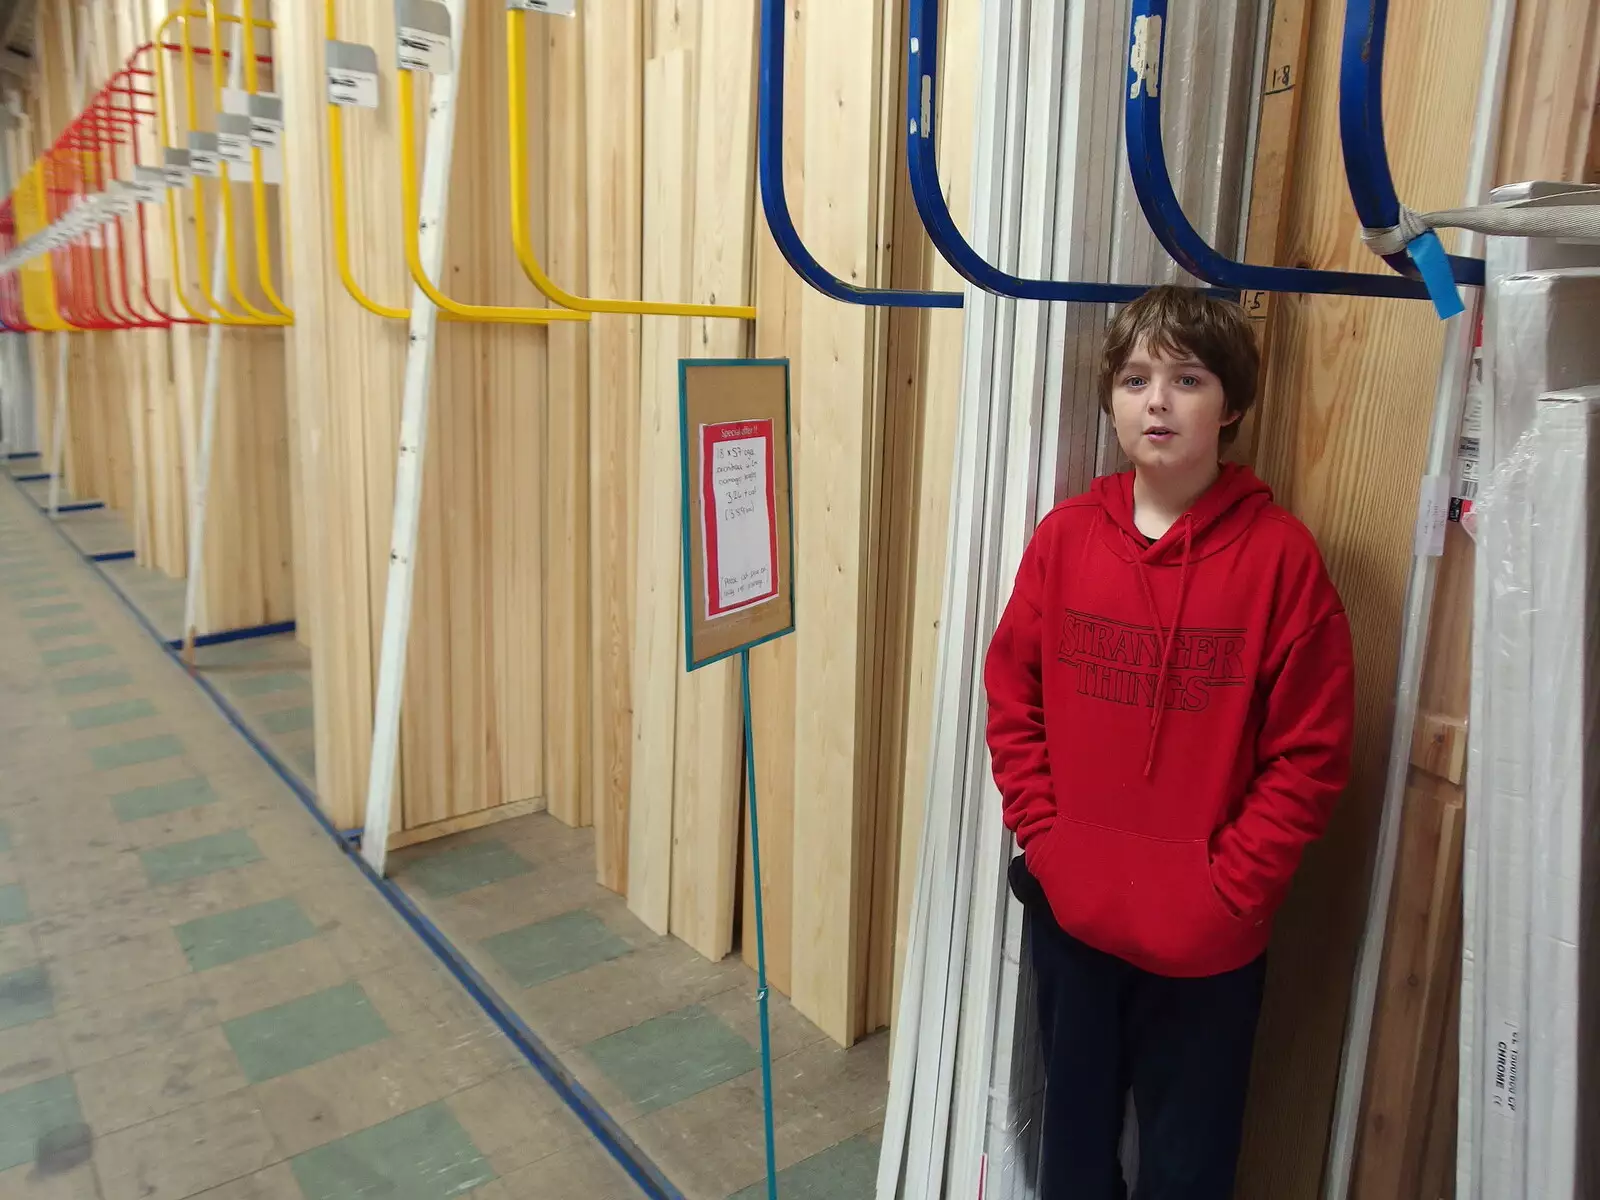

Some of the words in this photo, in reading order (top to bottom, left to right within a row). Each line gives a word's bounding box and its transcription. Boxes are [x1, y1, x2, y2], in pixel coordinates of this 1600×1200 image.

[720, 427, 740, 438] Special
[1058, 614, 1247, 679] STRANGER
[1076, 660, 1211, 712] THINGS
[1495, 1041, 1508, 1090] CHROME
